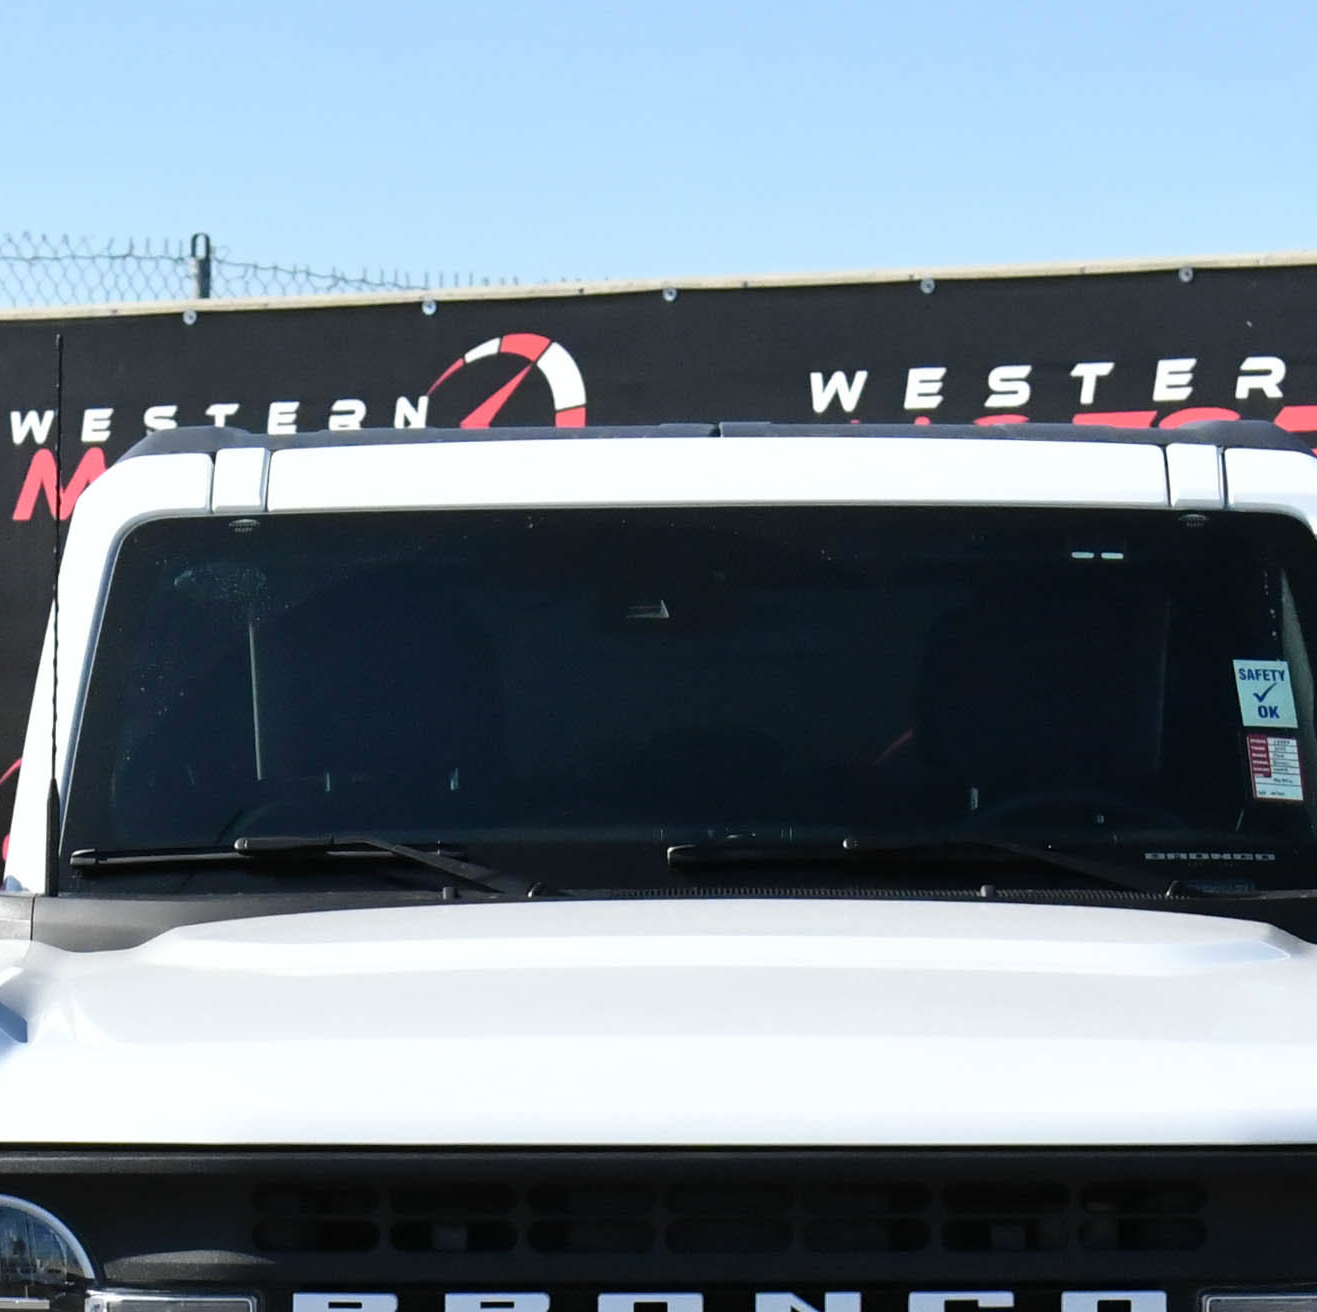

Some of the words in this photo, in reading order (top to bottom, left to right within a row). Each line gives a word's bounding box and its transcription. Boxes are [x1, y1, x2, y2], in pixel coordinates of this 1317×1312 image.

[10, 396, 429, 445] WESTERN
[1238, 667, 1286, 682] SAFETY
[1257, 705, 1280, 719] OK
